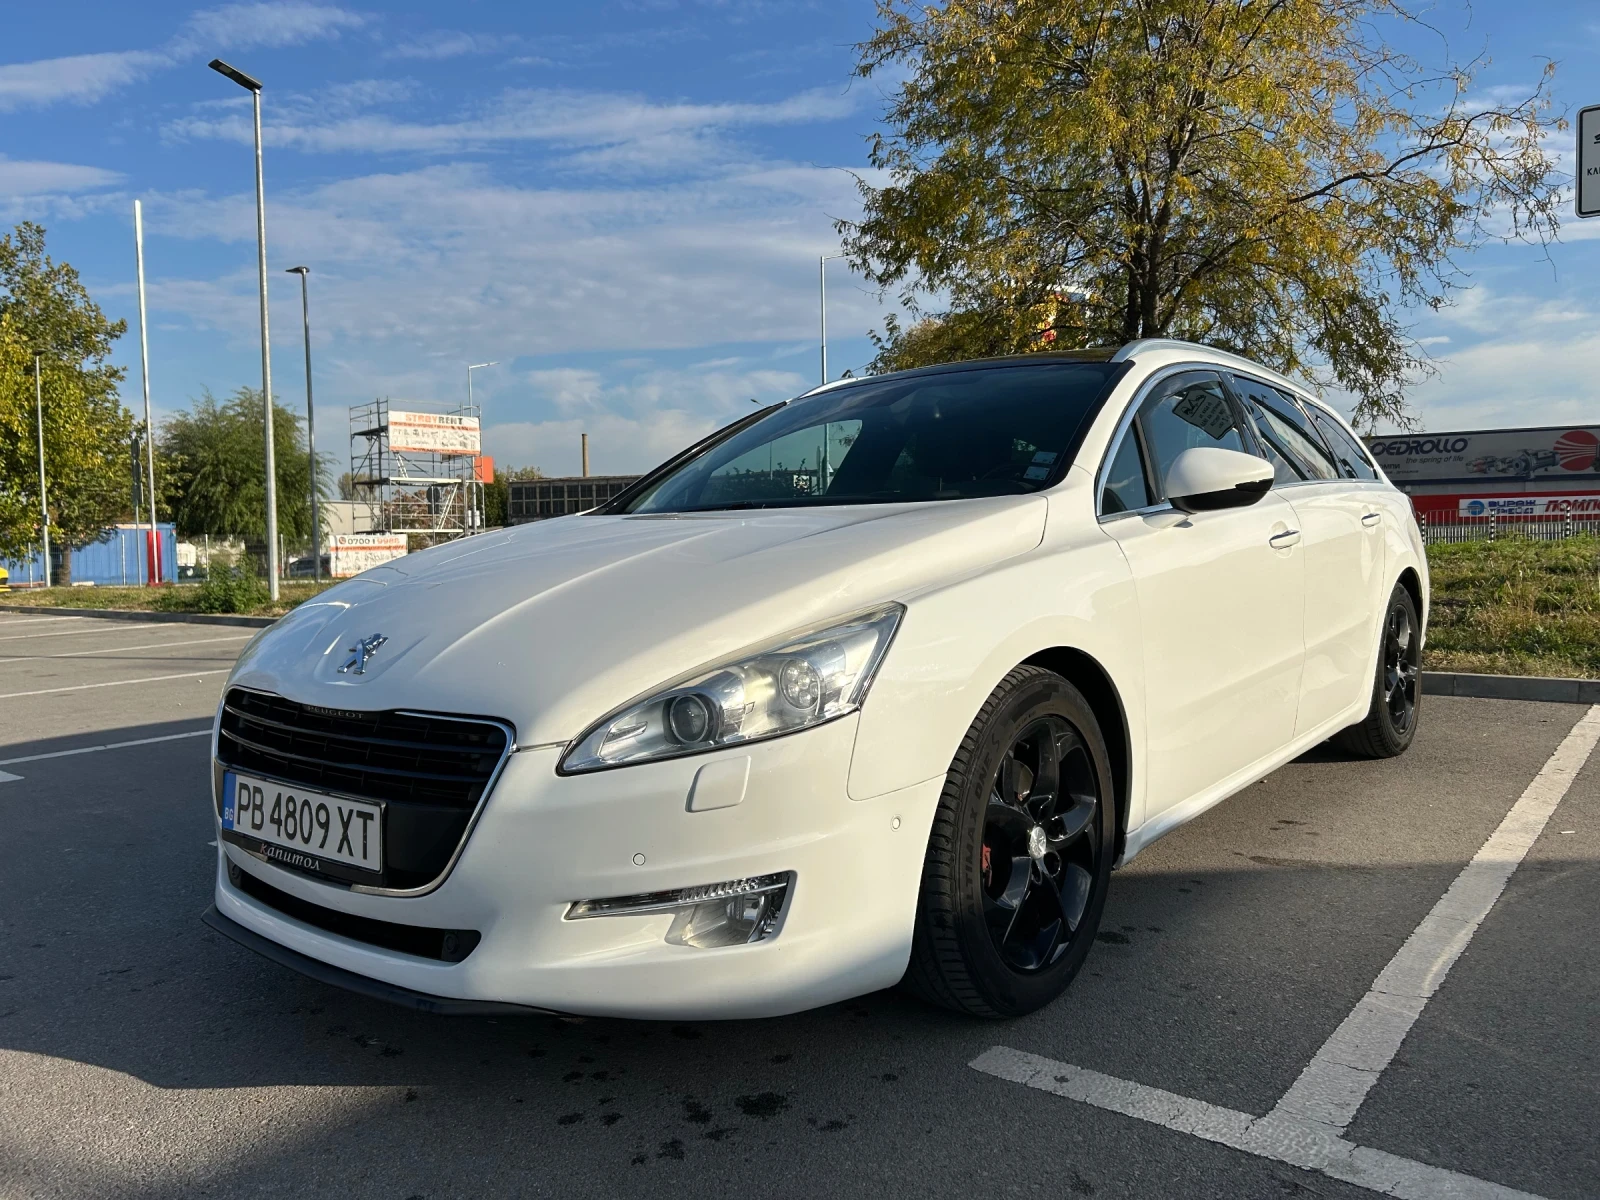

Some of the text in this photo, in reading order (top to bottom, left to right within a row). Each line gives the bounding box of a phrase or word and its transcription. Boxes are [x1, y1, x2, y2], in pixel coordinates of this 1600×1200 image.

[1419, 457, 1441, 465] spring
[307, 705, 365, 719] PEUGEOT
[224, 807, 234, 821] BG
[960, 806, 978, 918] ALTIMAX
[974, 754, 993, 801] ONE
